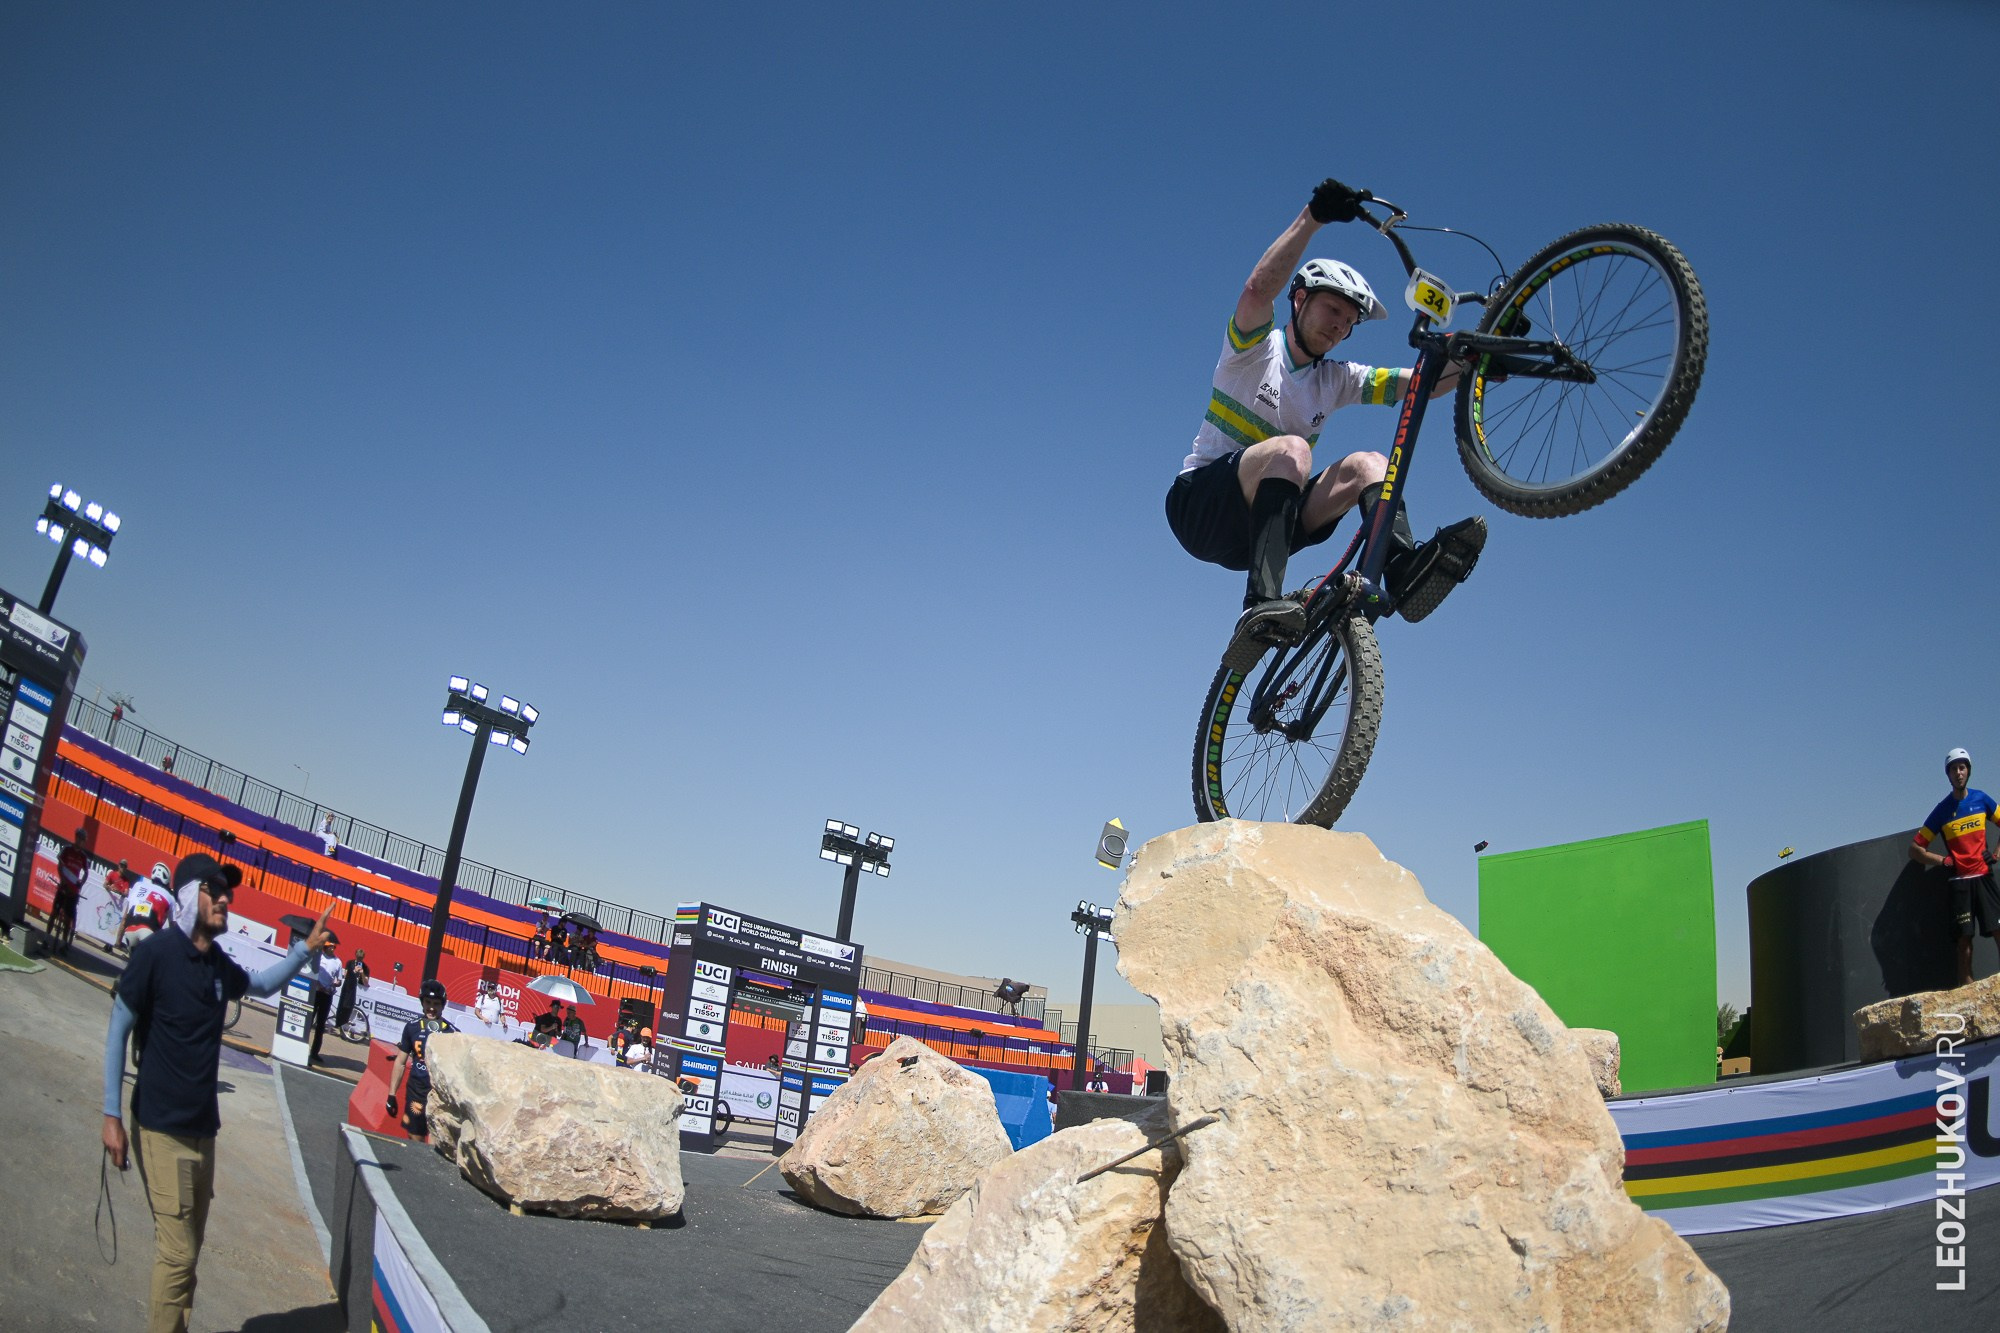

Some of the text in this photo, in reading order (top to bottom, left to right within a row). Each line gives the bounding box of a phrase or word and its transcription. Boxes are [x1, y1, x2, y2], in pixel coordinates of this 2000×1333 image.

[1423, 289, 1445, 313] 34
[19, 684, 52, 707] SHIMANO
[10, 735, 35, 753] TISSOT
[4, 780, 19, 792] UCI
[0, 850, 12, 866] CI
[713, 913, 737, 930] UCI
[741, 926, 799, 947] WORLD CHAMPIONSHIPS
[753, 923, 770, 933] URBAN
[770, 928, 791, 938] CYCLING
[703, 964, 727, 980] UCI
[761, 957, 798, 976] FINISH
[477, 979, 521, 1000] RIADH
[822, 994, 852, 1006] SHIMANO
[376, 1008, 392, 1016] WORLD
[400, 1010, 419, 1019] CYCLING
[694, 1007, 720, 1018] TISSOT
[791, 1028, 807, 1036] TISSOT
[822, 1033, 844, 1042] TISSOT
[695, 1043, 710, 1053] UCI
[682, 1060, 717, 1072] SHIMANO
[790, 1061, 800, 1069] UCI
[822, 1066, 836, 1075] UCI
[783, 1076, 803, 1086] SHIMANO
[812, 1081, 838, 1091] SHIMAN
[684, 1097, 709, 1112] UCI
[782, 1109, 797, 1123] UCI
